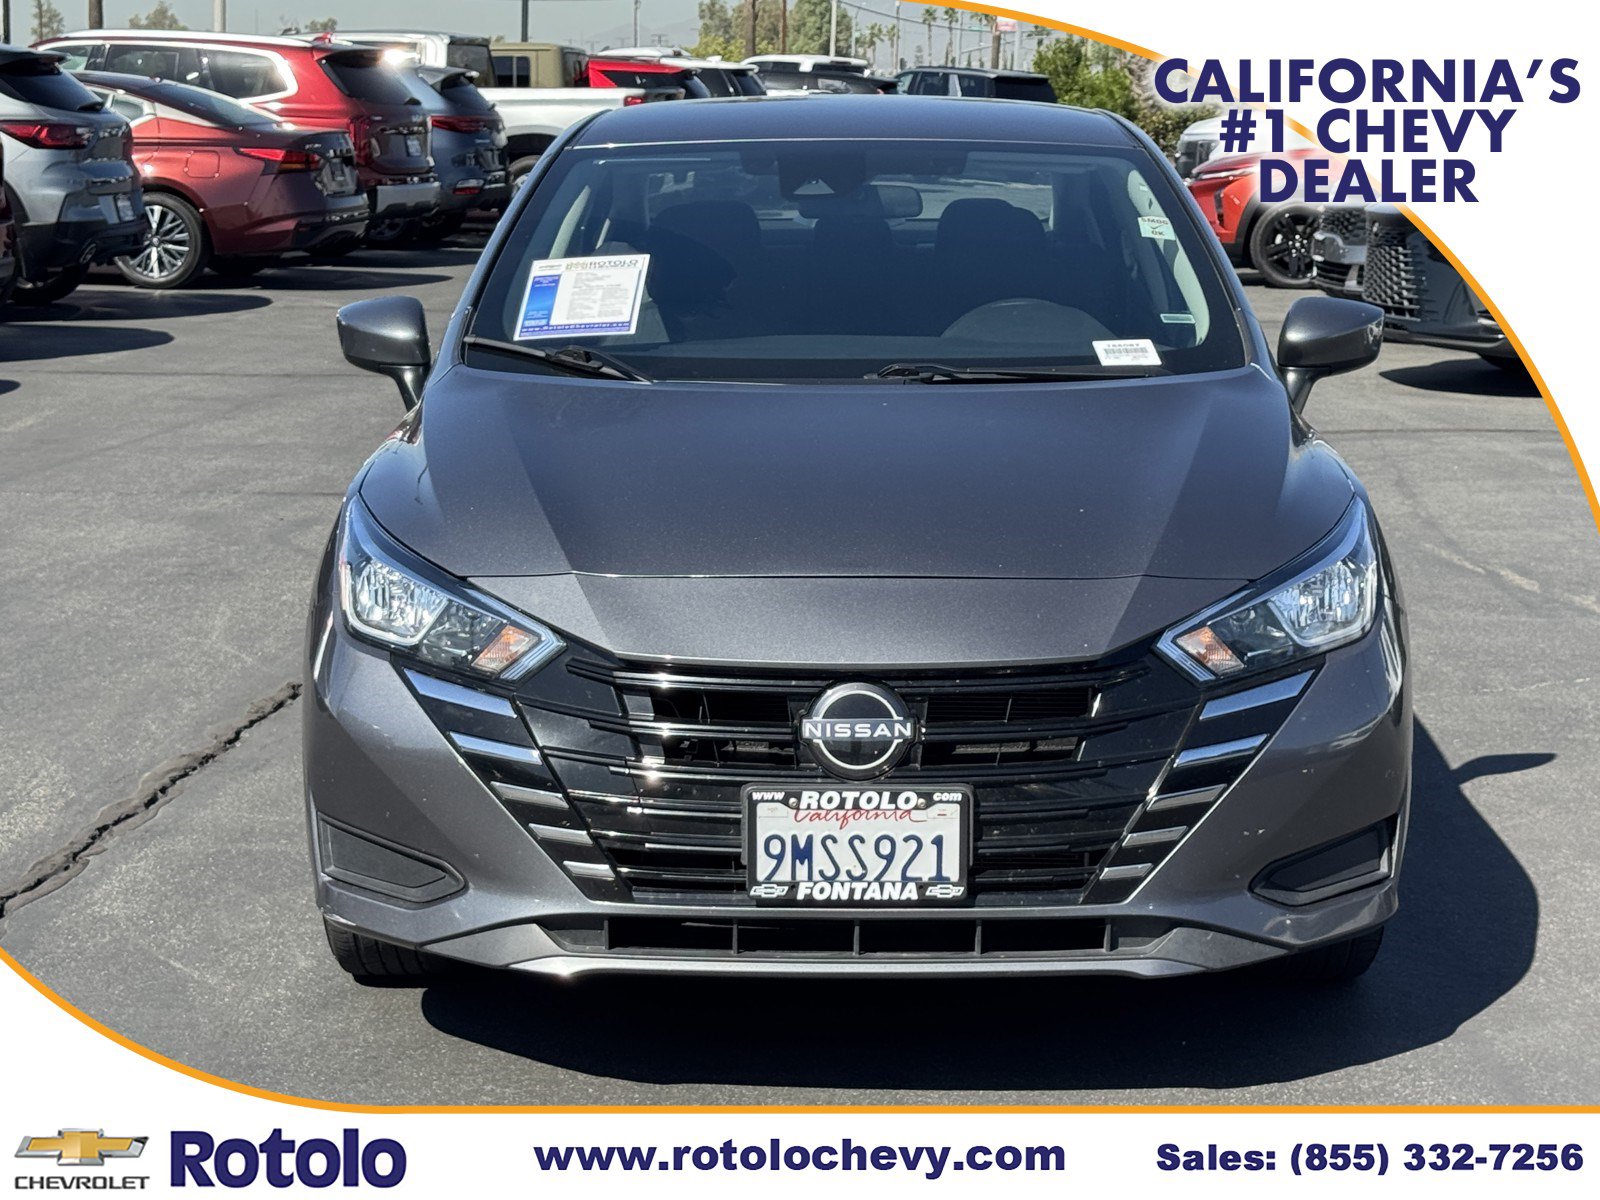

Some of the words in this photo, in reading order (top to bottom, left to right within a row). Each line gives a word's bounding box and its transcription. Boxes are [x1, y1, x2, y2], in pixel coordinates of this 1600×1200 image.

[1141, 217, 1169, 225] SMOG
[803, 722, 912, 738] NISSAN
[751, 791, 786, 801] www
[798, 790, 918, 810] ROTOLO
[932, 791, 963, 802] com
[793, 808, 927, 830] California
[763, 834, 951, 881] 9MSS921
[796, 881, 919, 901] FONTANA
